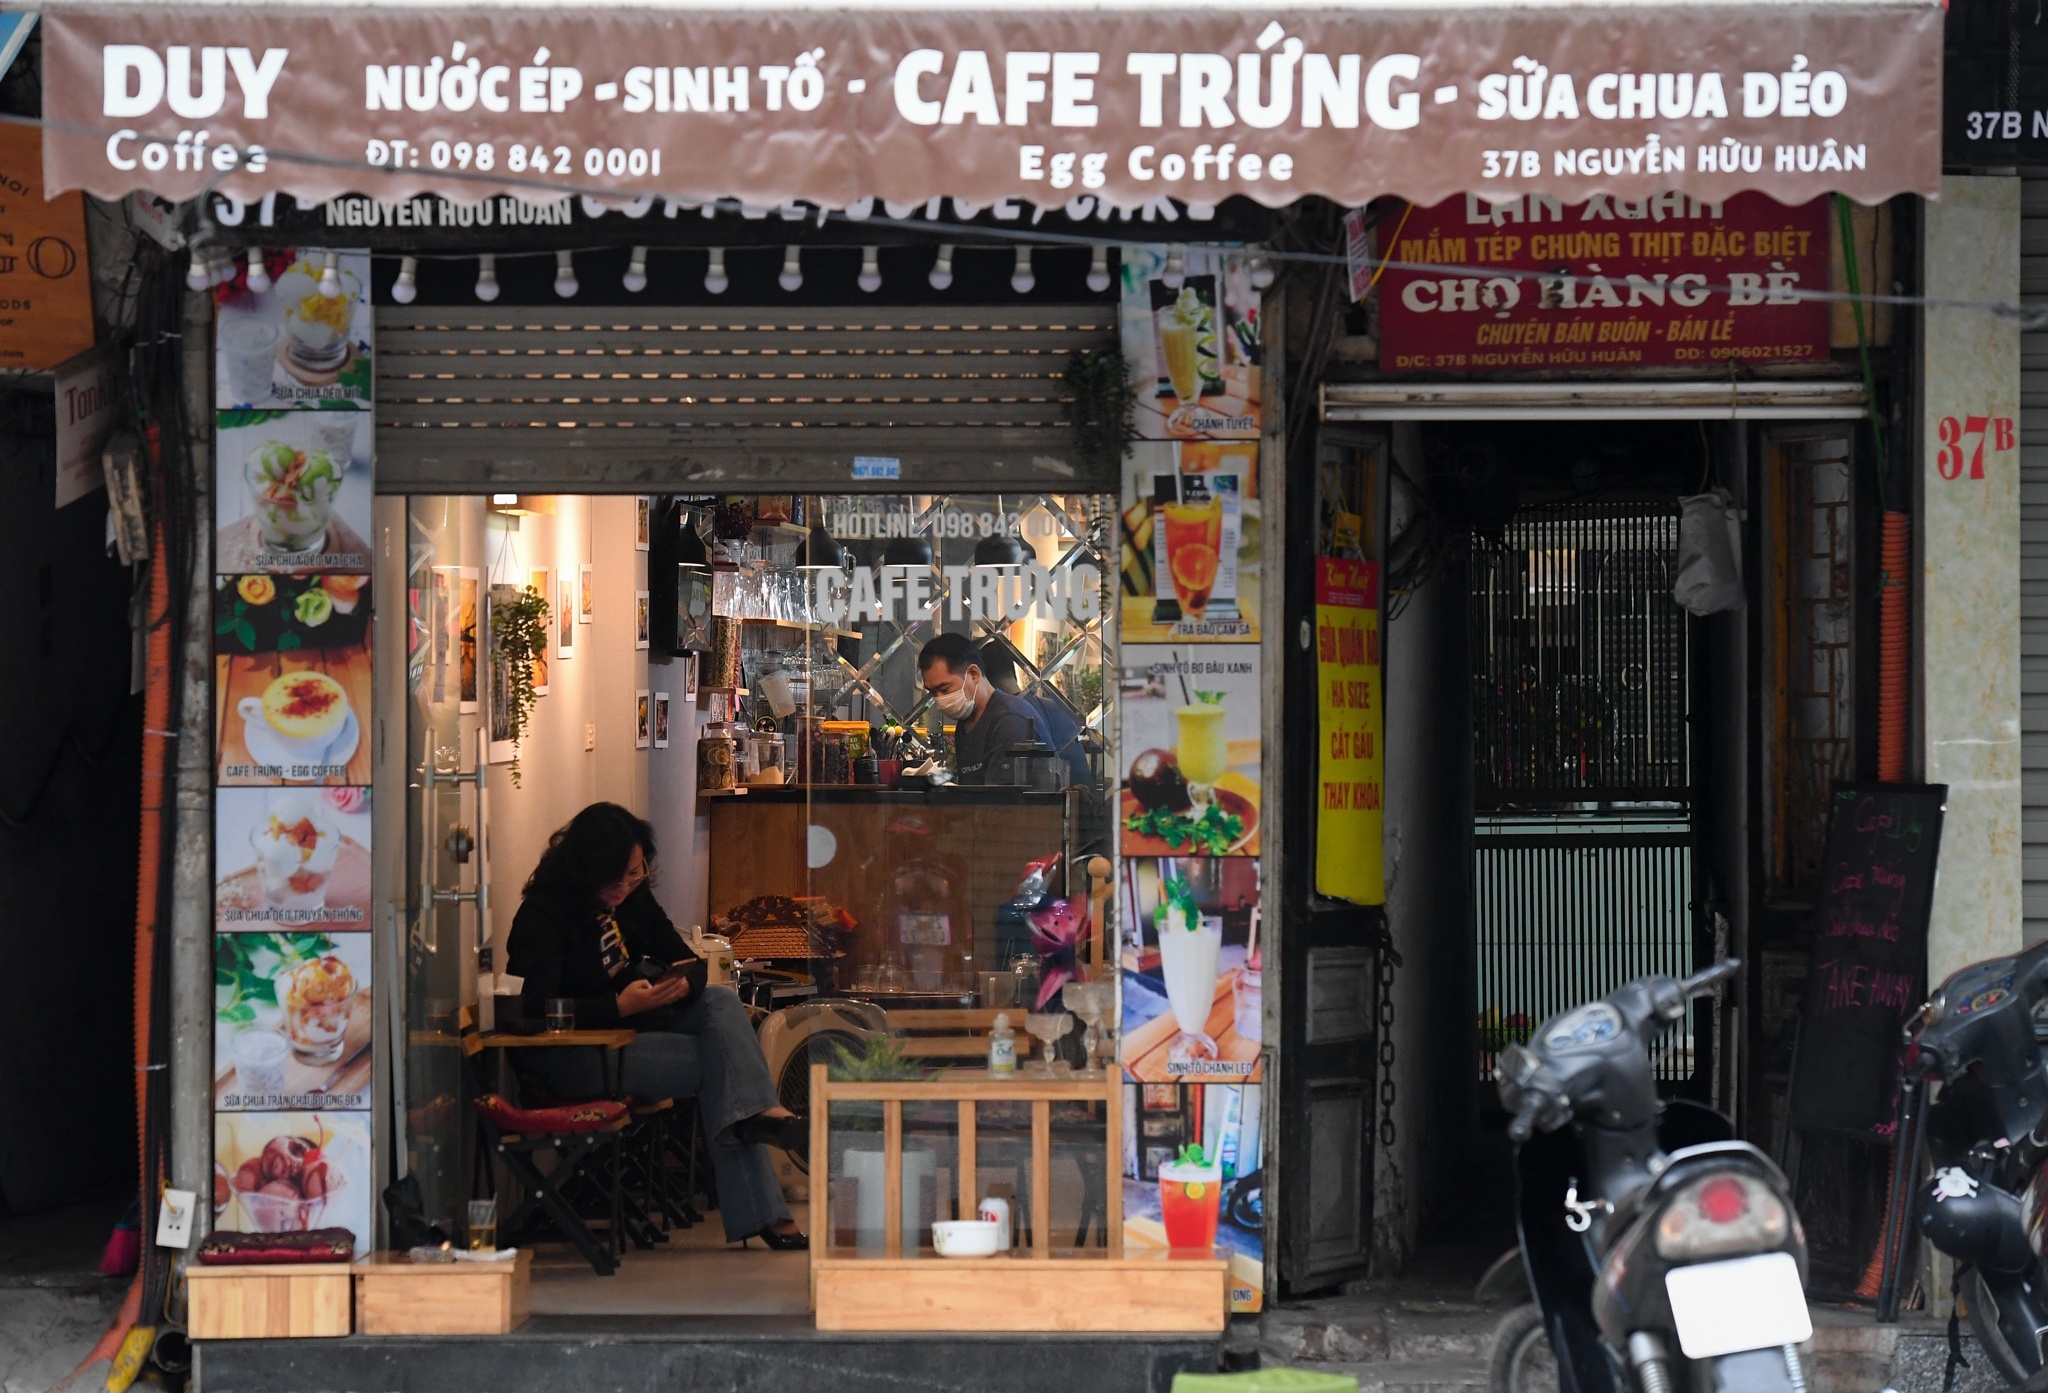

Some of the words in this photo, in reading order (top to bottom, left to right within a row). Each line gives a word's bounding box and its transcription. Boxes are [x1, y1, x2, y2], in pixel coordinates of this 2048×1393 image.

[103, 45, 289, 119] DUY
[365, 41, 511, 112] NƯỚC
[518, 47, 582, 113] ÉP
[624, 66, 750, 112] SINH
[759, 47, 826, 112] TỐ
[893, 48, 1100, 127] CAFE
[1126, 20, 1421, 129] TRỨNG
[1477, 55, 1580, 120] SỮA
[1587, 72, 1729, 119] CHUA
[1743, 54, 1848, 118] DẺO
[1966, 110, 2023, 141] 37B
[365, 139, 420, 168] ĐT:
[430, 140, 495, 171] 098
[507, 144, 573, 175] 842
[583, 147, 661, 177] 0001
[1019, 145, 1108, 188] Egg
[1127, 143, 1294, 181] Coffee
[1481, 150, 1542, 179] 37B
[1554, 133, 1686, 176] NGUYỄN
[1697, 136, 1763, 172] HỮU
[1775, 136, 1867, 172] HUÂN
[1475, 228, 1522, 262] TÉP
[1530, 229, 1621, 260] CHƯNG
[1629, 231, 1685, 263] THỊT
[1691, 224, 1745, 262] ĐẶC
[1753, 224, 1812, 262] BIỆT
[1401, 275, 1522, 319] CHỢ
[1537, 263, 1713, 310] HÀNG
[1725, 263, 1802, 307] BÈ
[1476, 319, 1550, 346] CHUYÊN
[1553, 317, 1597, 344] BÁN
[1597, 316, 1650, 344] BUÔN
[1666, 315, 1708, 343] BÁN
[1710, 310, 1735, 342] LẺ
[1435, 354, 1467, 367] 37B
[1709, 344, 1813, 360] 0906021527
[932, 512, 974, 539] 098
[816, 564, 932, 623] CAFE
[1153, 662, 1177, 674] SINH
[1226, 662, 1253, 674] XANH
[292, 764, 309, 777] EGG
[312, 764, 347, 777] COFFEE
[245, 908, 269, 922] CHUA
[1167, 1062, 1188, 1074] SINH
[1203, 1062, 1234, 1074] CHANH
[1236, 1062, 1253, 1074] LEO
[242, 1094, 266, 1108] CHUA
